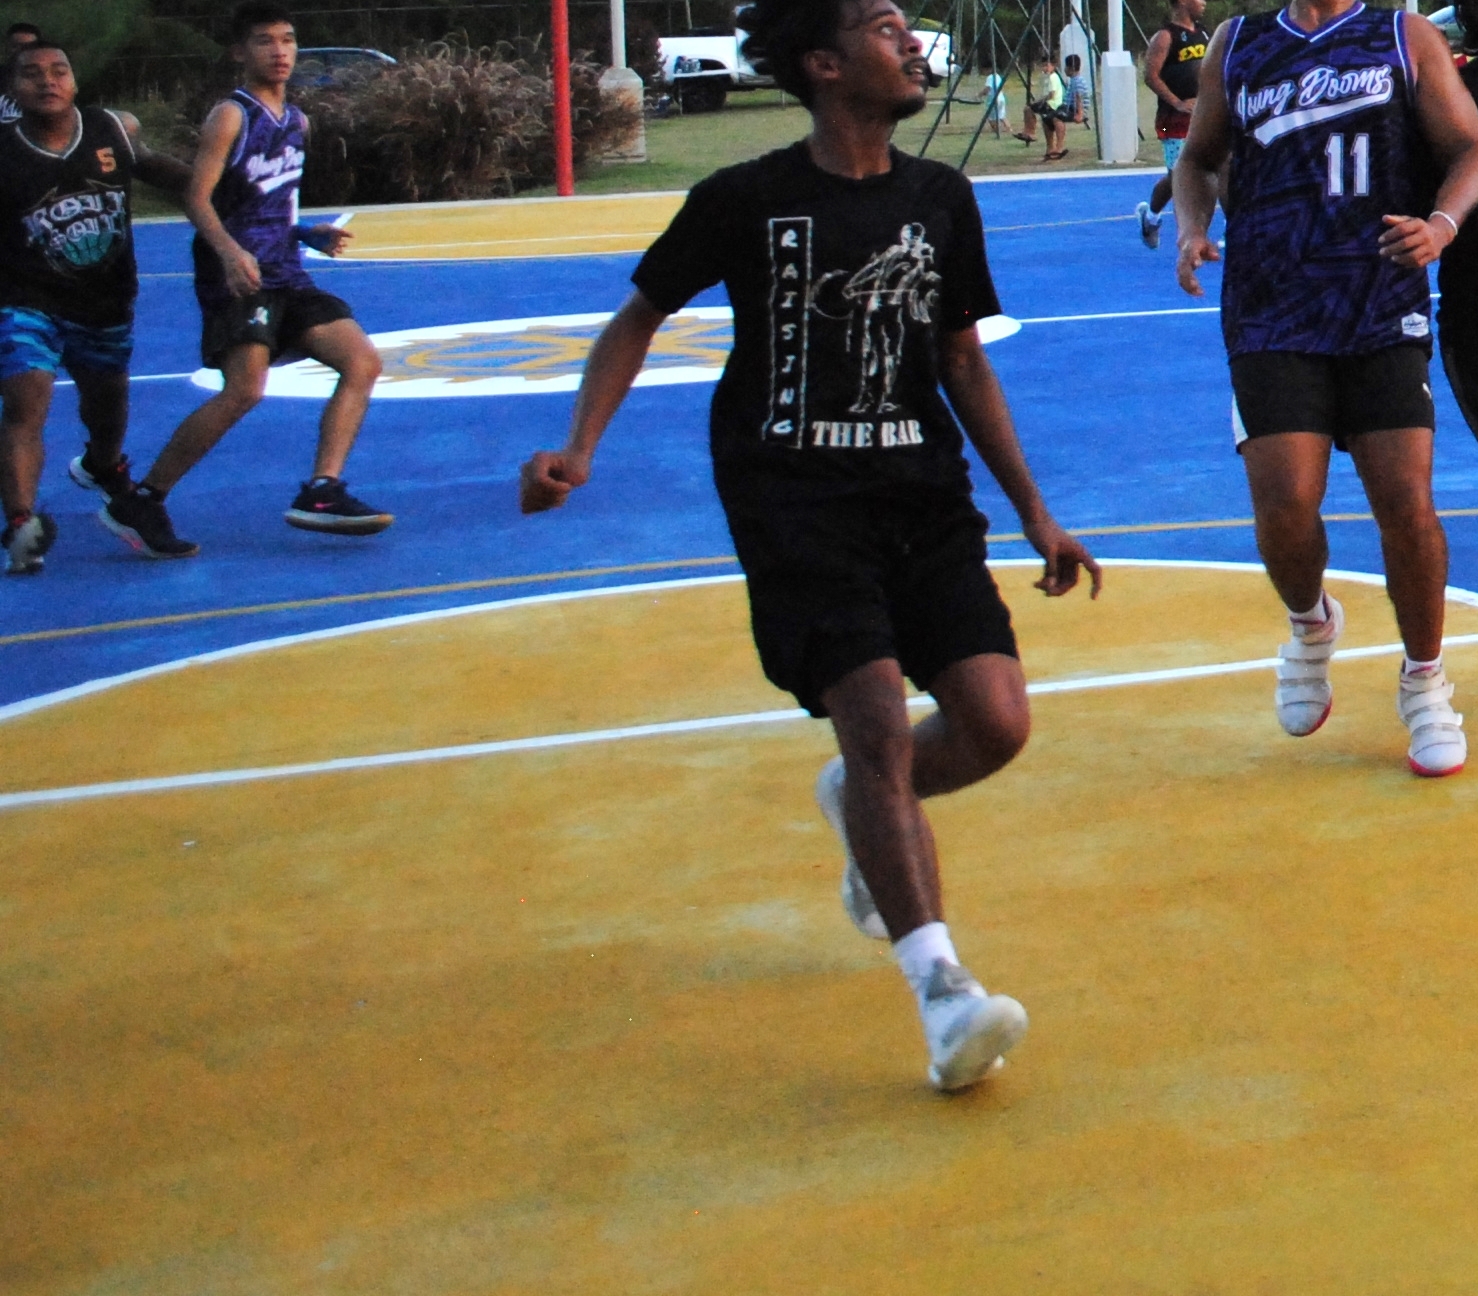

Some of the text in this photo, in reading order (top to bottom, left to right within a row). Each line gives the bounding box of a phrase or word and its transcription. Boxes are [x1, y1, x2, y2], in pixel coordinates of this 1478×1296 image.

[1324, 132, 1370, 196] 11
[772, 228, 799, 435] RAISING
[812, 419, 924, 448] THE BAR
